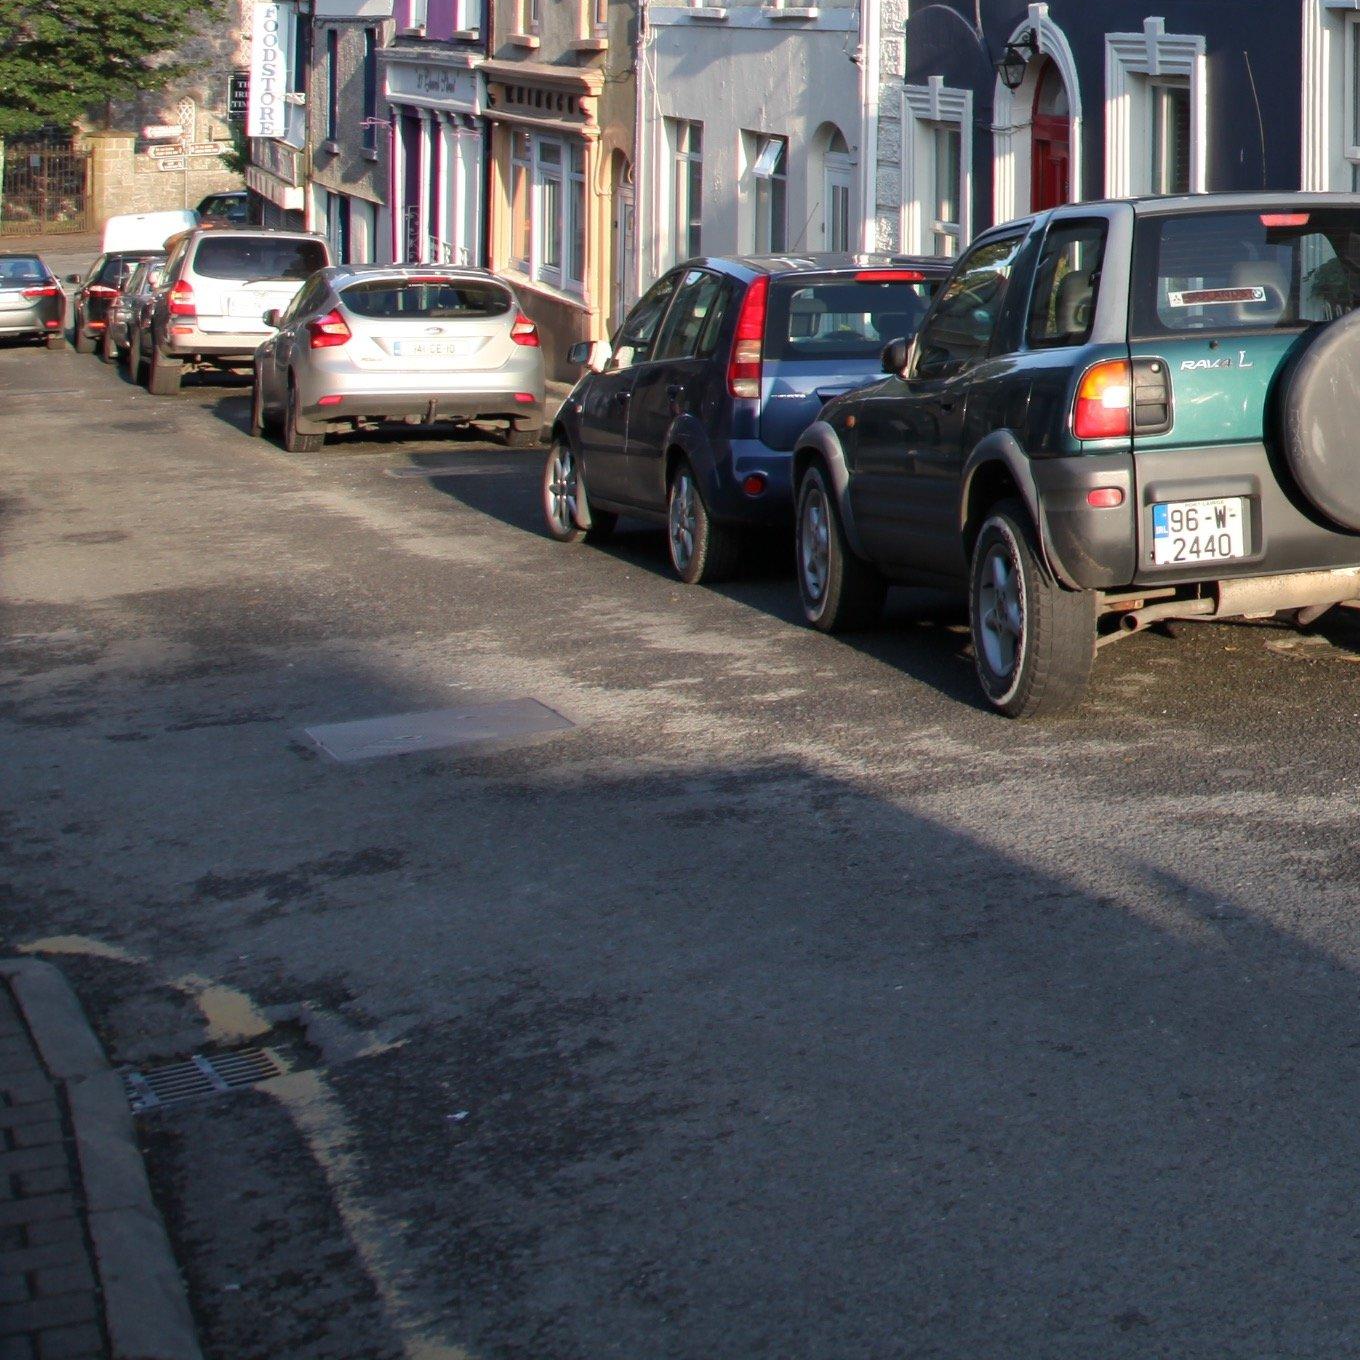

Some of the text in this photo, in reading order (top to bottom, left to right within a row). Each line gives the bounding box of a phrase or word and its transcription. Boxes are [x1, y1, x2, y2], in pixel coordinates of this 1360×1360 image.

[260, 5, 279, 136] FOODSTORE
[1239, 350, 1254, 368] L
[1173, 533, 1232, 562] 2440
